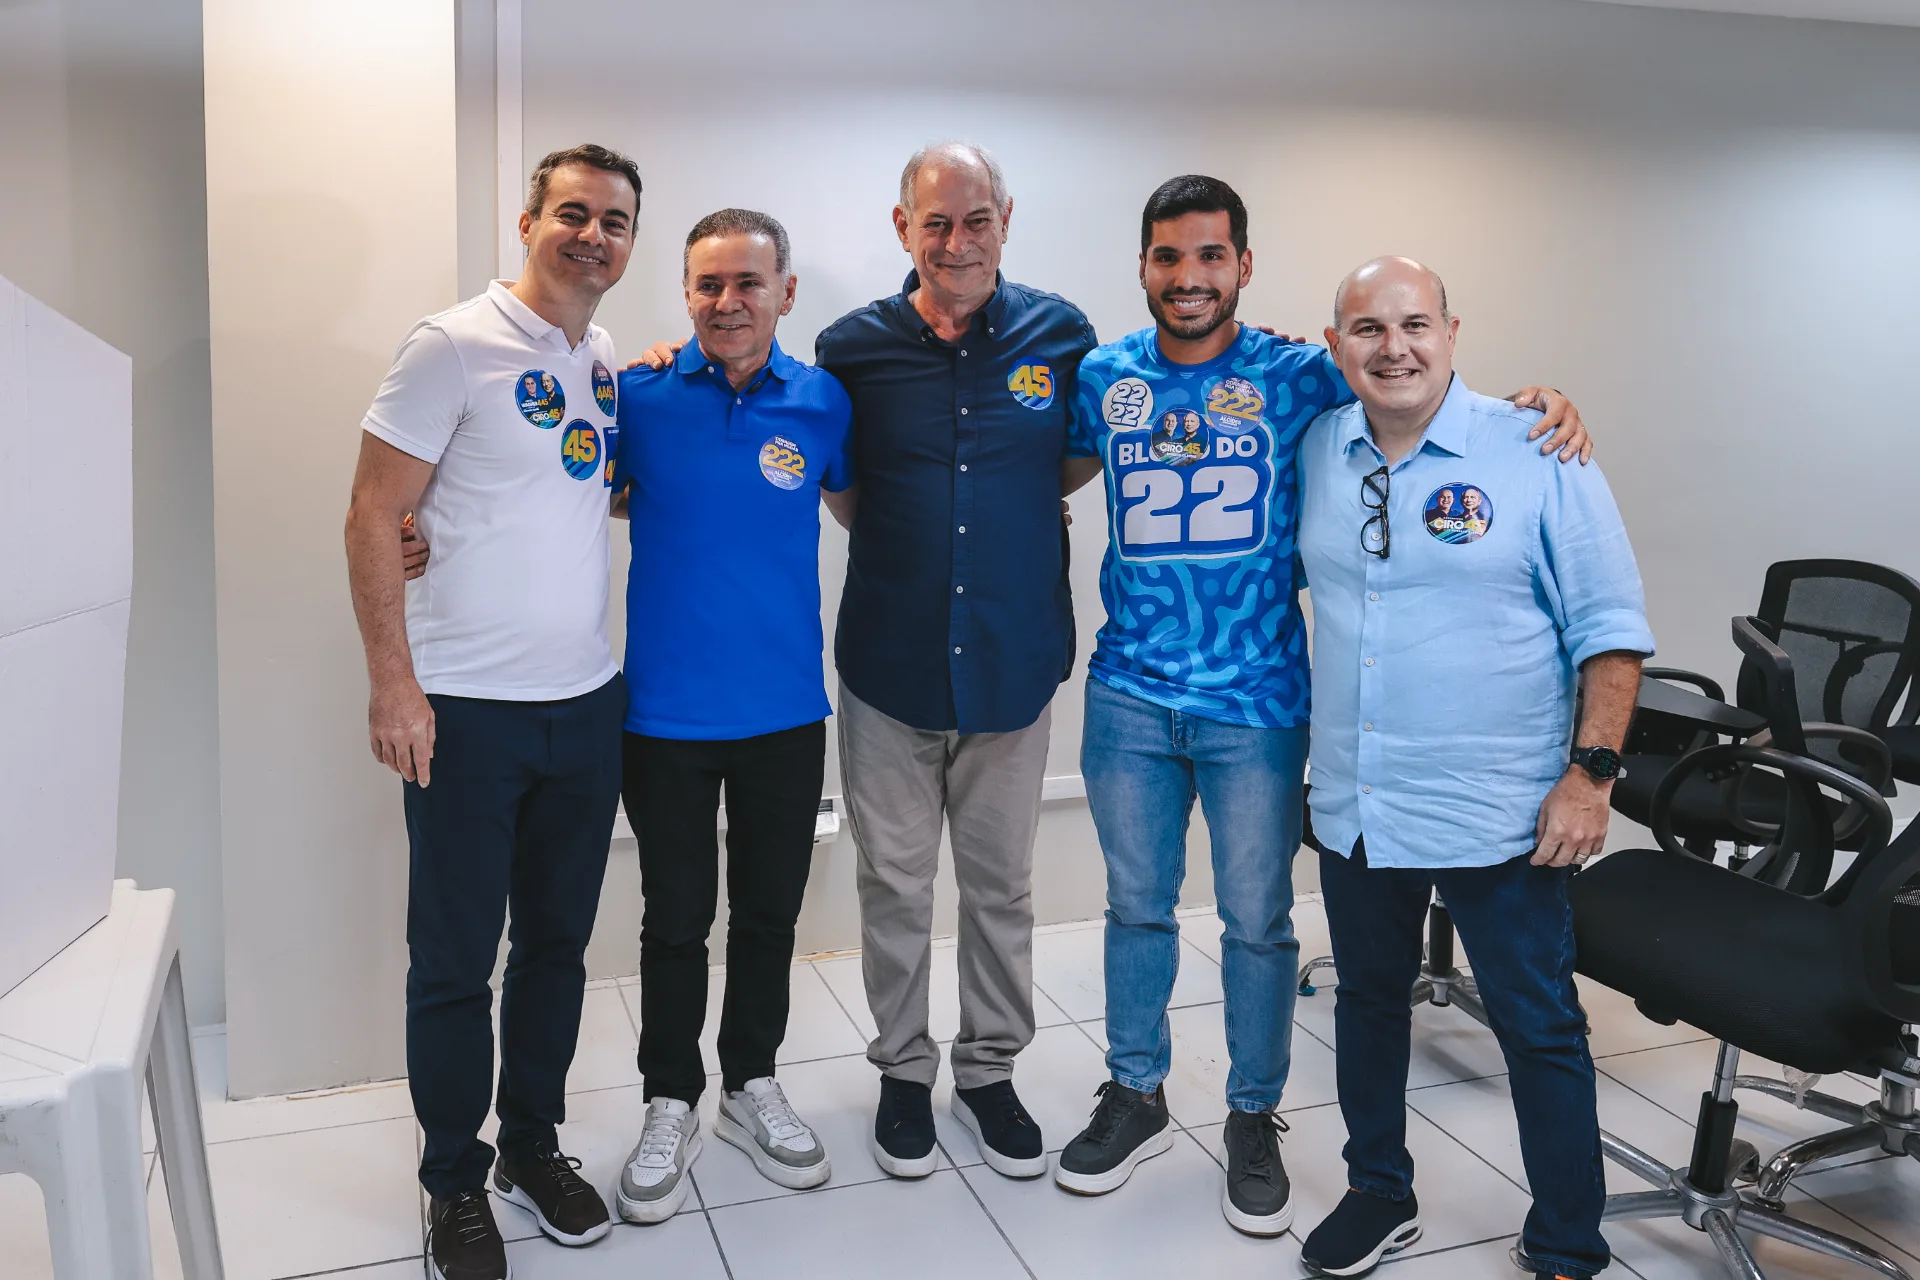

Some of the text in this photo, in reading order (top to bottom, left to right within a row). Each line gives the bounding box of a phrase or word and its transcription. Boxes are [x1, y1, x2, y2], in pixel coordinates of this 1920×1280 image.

[1009, 365, 1052, 398] 45
[1112, 382, 1147, 407] 22
[1108, 404, 1142, 427] 22
[1208, 388, 1262, 421] 222
[563, 429, 597, 463] 45
[1159, 443, 1183, 453] CIRO
[1183, 442, 1201, 455] 45
[1216, 435, 1259, 459] DO
[762, 444, 805, 478] 222
[1121, 465, 1259, 545] 22
[1434, 519, 1465, 530] CIRO
